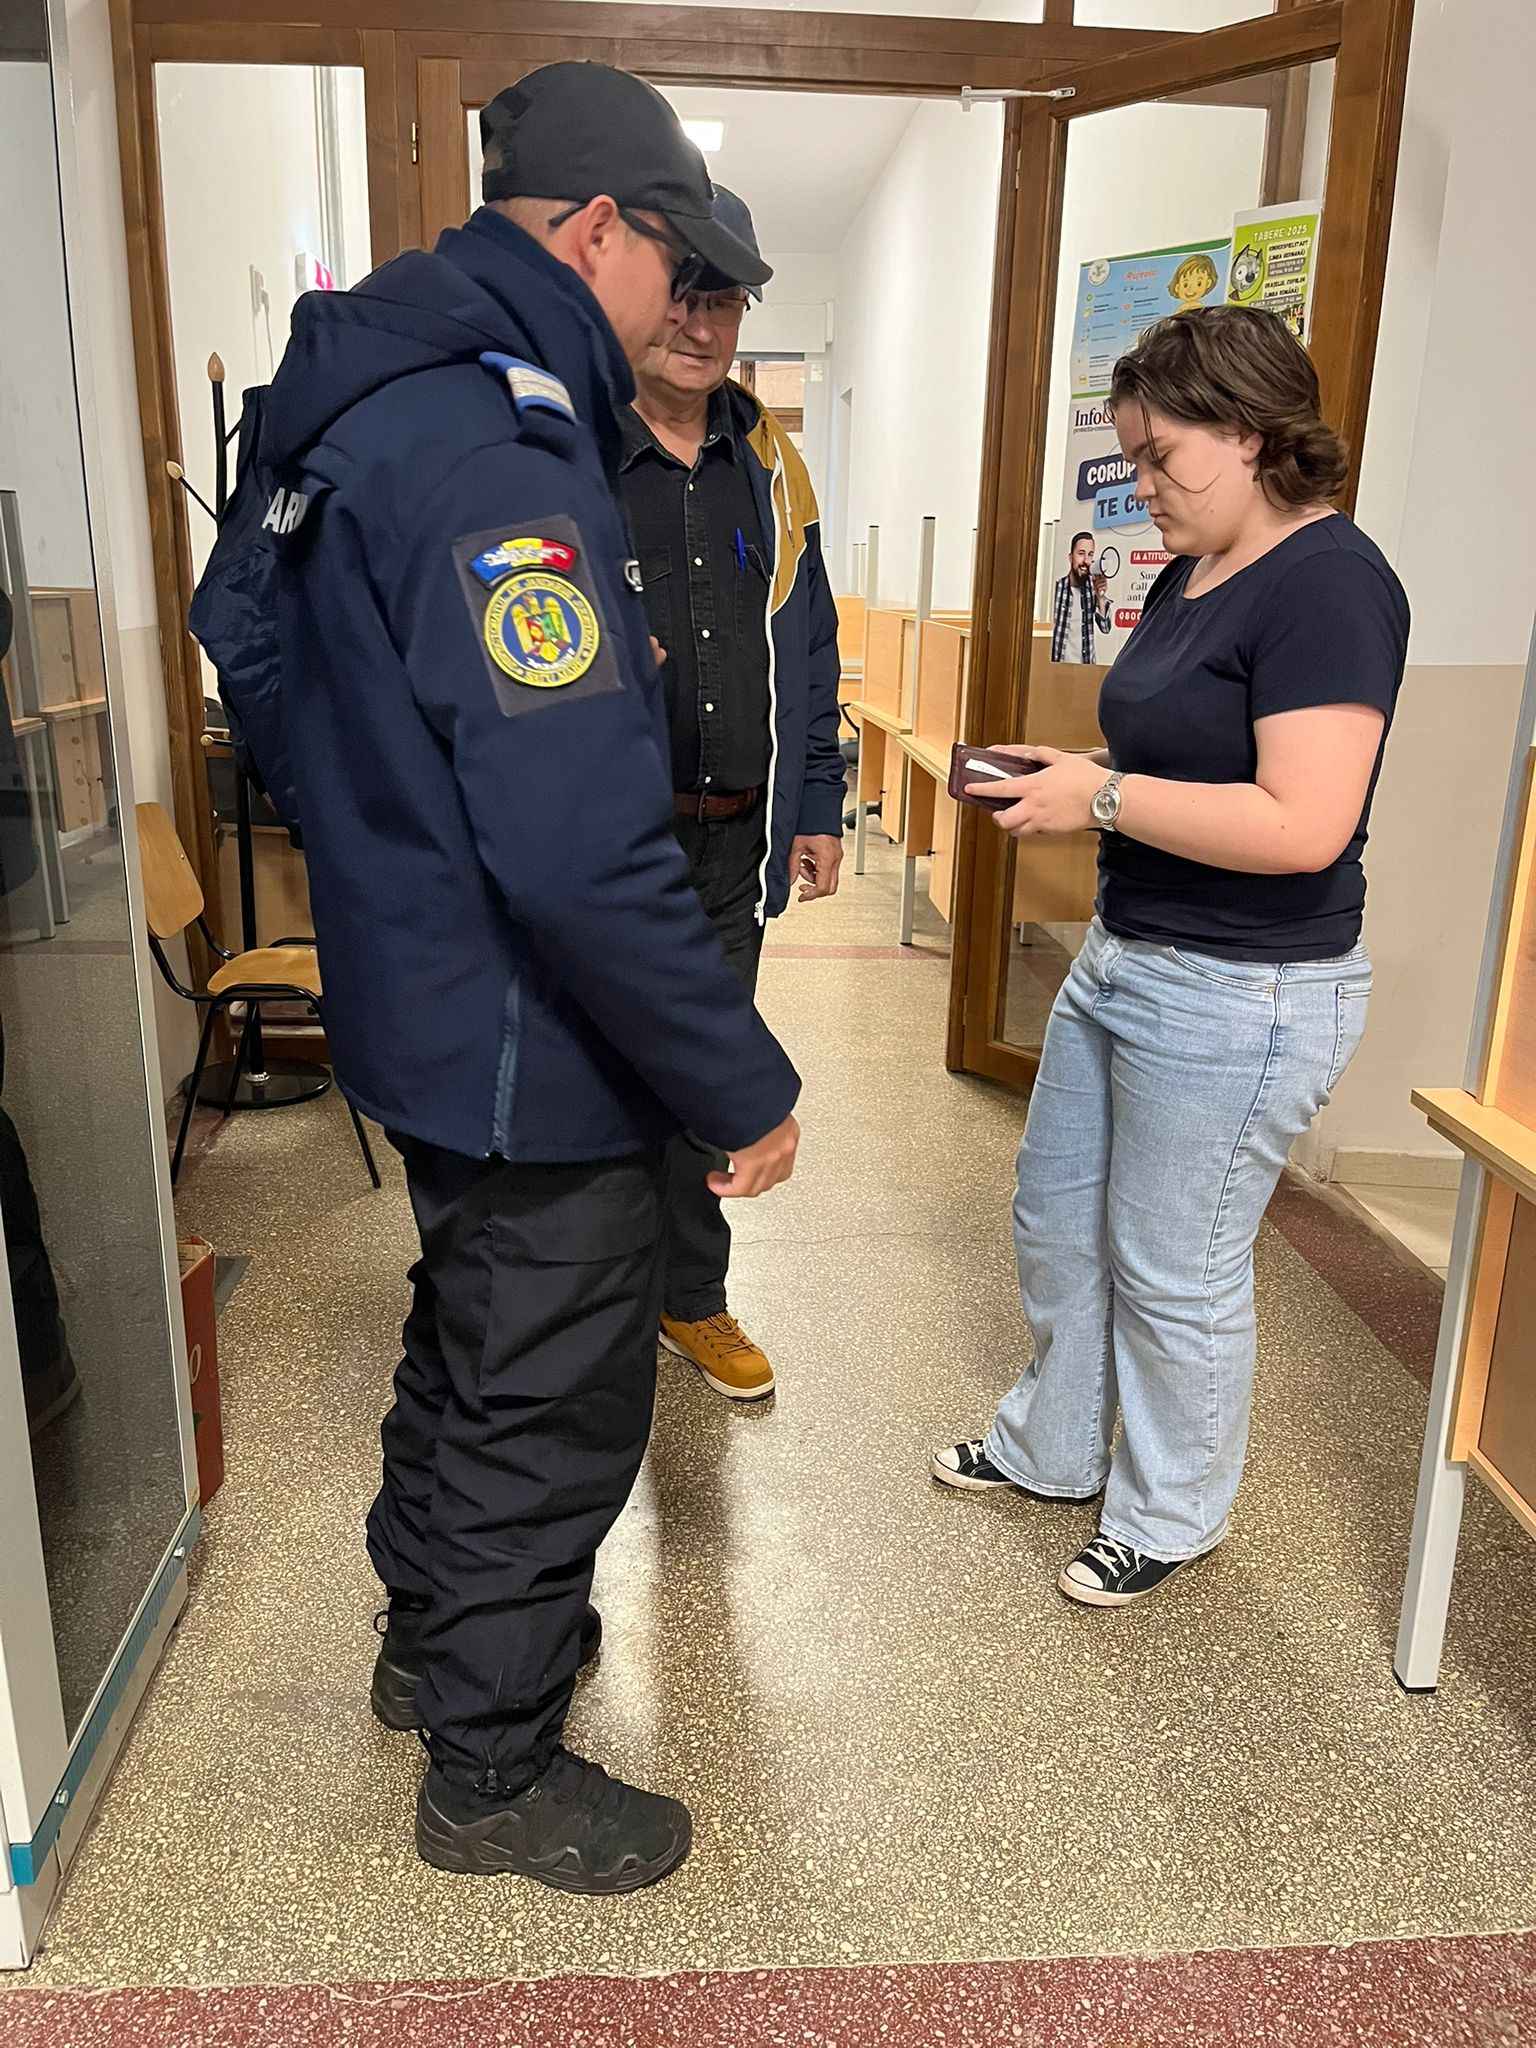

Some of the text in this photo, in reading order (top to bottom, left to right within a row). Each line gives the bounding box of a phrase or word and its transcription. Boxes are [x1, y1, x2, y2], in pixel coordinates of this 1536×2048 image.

[1287, 224, 1308, 237] 2025
[1097, 493, 1149, 519] TE CO
[1133, 552, 1141, 561] IA
